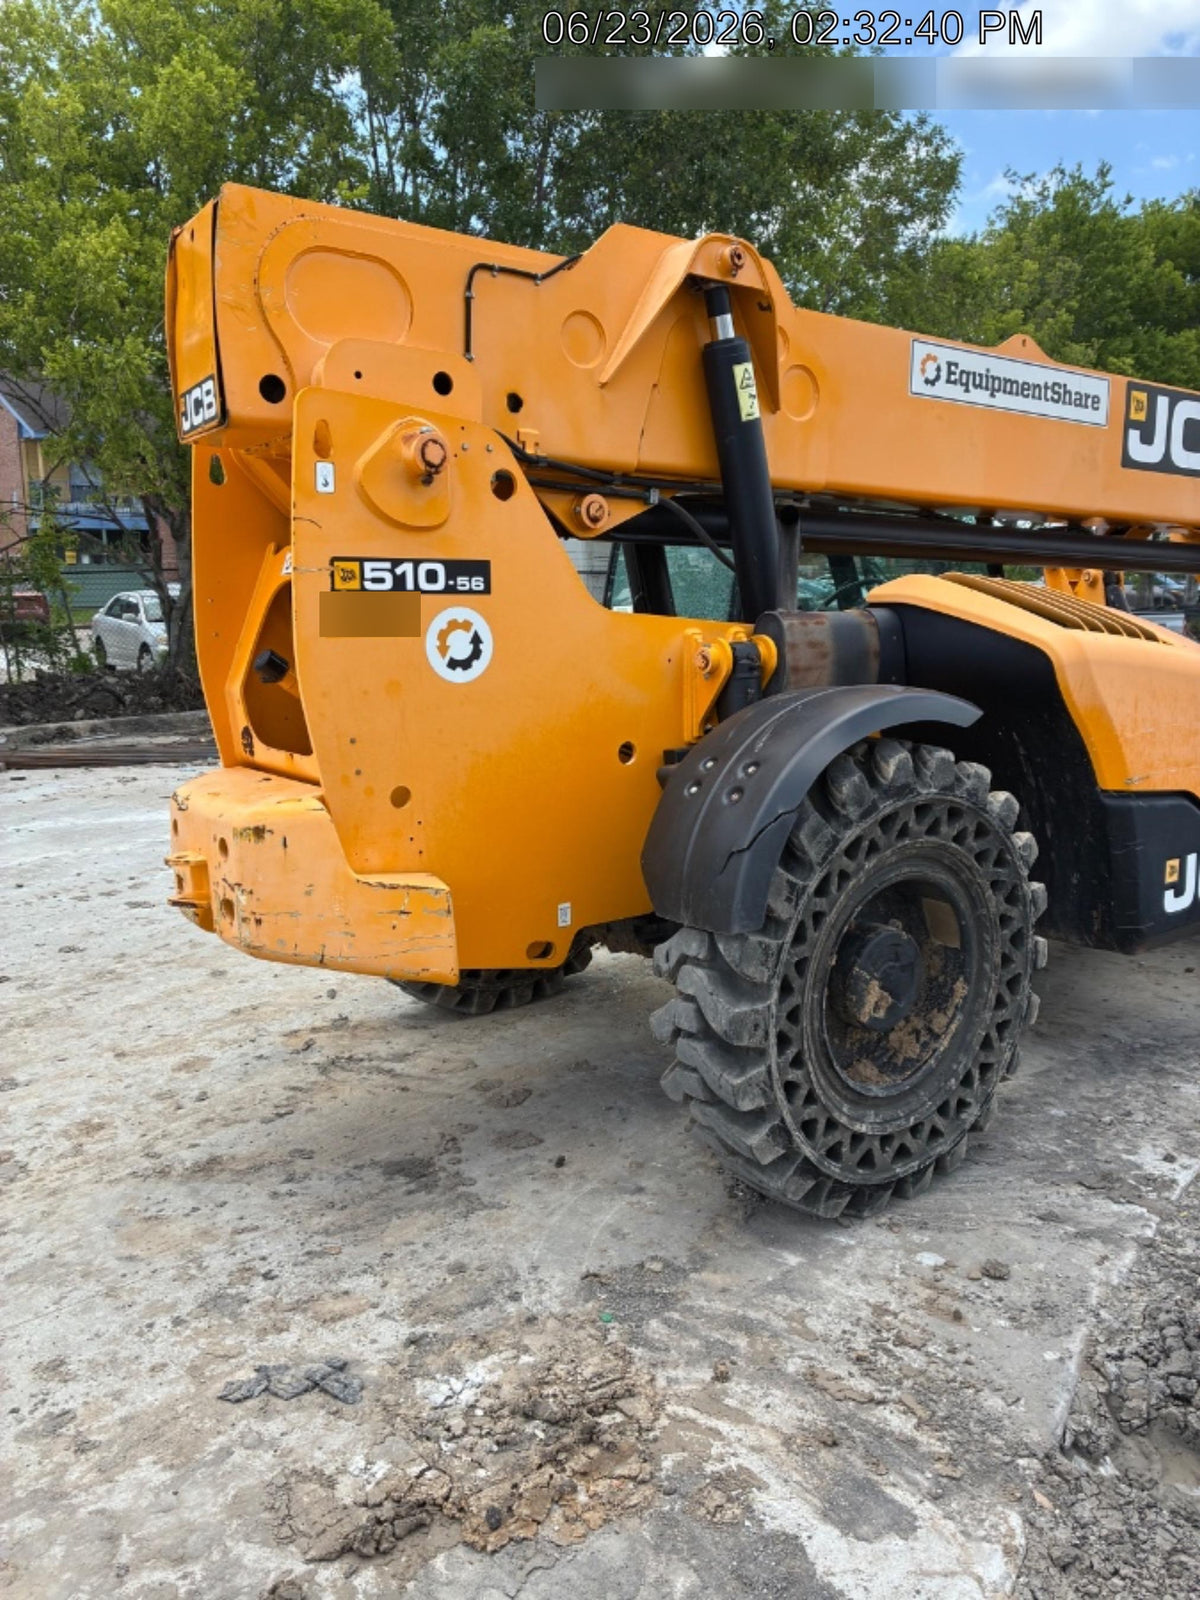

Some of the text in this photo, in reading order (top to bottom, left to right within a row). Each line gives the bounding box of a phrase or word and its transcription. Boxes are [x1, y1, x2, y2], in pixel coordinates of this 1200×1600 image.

[181, 378, 217, 432] JCB
[945, 360, 1101, 412] EquipmentShare
[362, 561, 485, 592] 510-56
[1163, 853, 1200, 913] J
